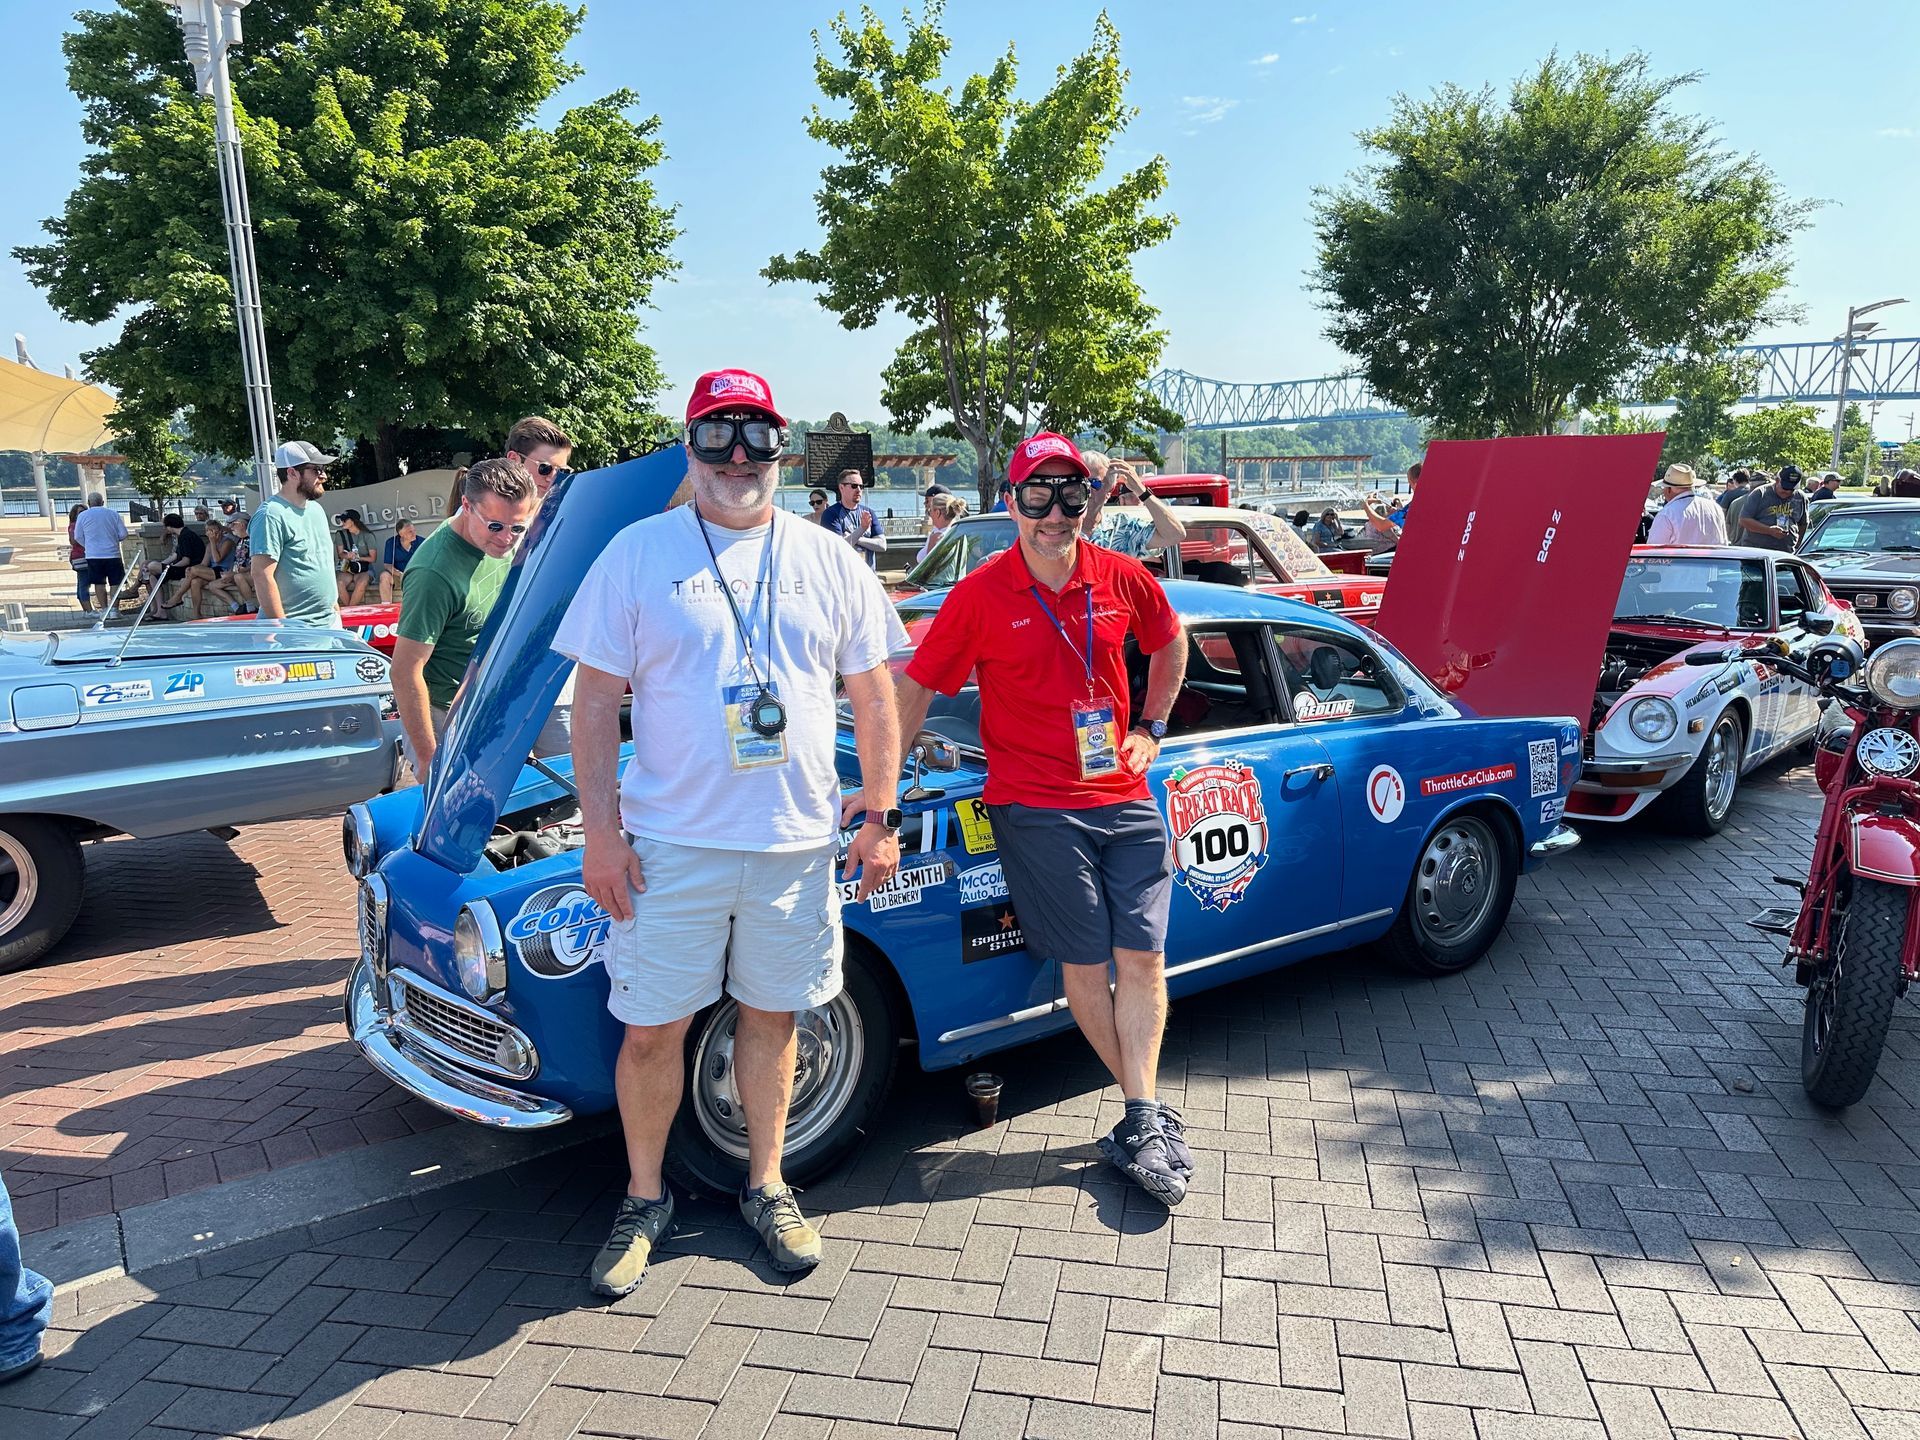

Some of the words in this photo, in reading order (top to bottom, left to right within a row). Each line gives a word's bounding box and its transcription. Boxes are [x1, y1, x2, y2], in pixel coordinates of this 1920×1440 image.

[1537, 527, 1556, 563] 240
[672, 579, 805, 595] THROTTLE
[1011, 618, 1031, 629] STAFF
[243, 666, 263, 680] GREAT
[287, 662, 316, 678] JOIN
[86, 683, 148, 697] Corvette
[164, 669, 204, 695] Zip
[98, 690, 151, 704] Central
[1299, 700, 1353, 718] REDLINE
[1091, 734, 1103, 742] 100
[1425, 768, 1513, 792] ThrottleCarClub.com
[1169, 790, 1219, 837] GREAT
[1220, 781, 1262, 823] RACE
[1189, 823, 1249, 866] 100
[902, 865, 944, 888] SMITH
[872, 896, 887, 910] OLD
[889, 889, 920, 906] BREWERY
[962, 889, 988, 903] Auto
[989, 937, 1025, 951] STAR
